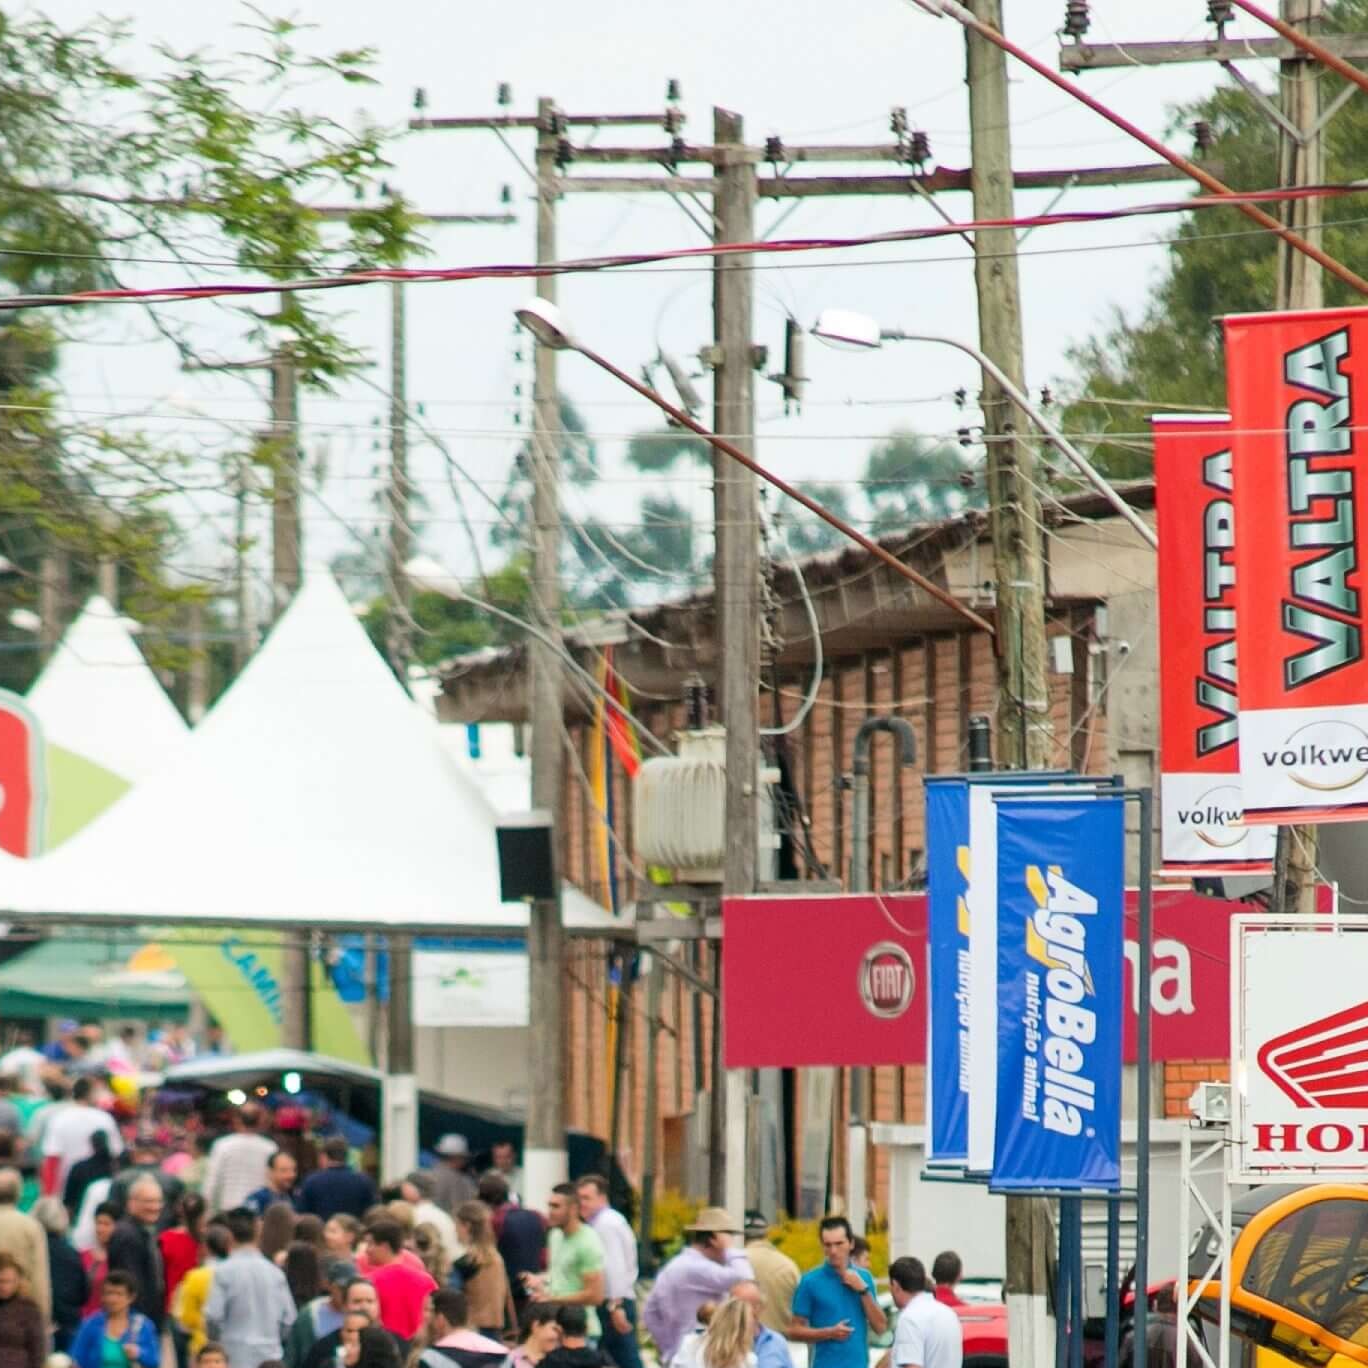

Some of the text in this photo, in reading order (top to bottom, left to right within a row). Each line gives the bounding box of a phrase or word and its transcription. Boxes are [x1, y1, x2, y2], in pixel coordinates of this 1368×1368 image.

[1282, 324, 1364, 692] VALTRA
[872, 965, 904, 1000] FIAT
[1022, 971, 1041, 1122] nutrição animal
[1033, 868, 1098, 1137] AgroBella
